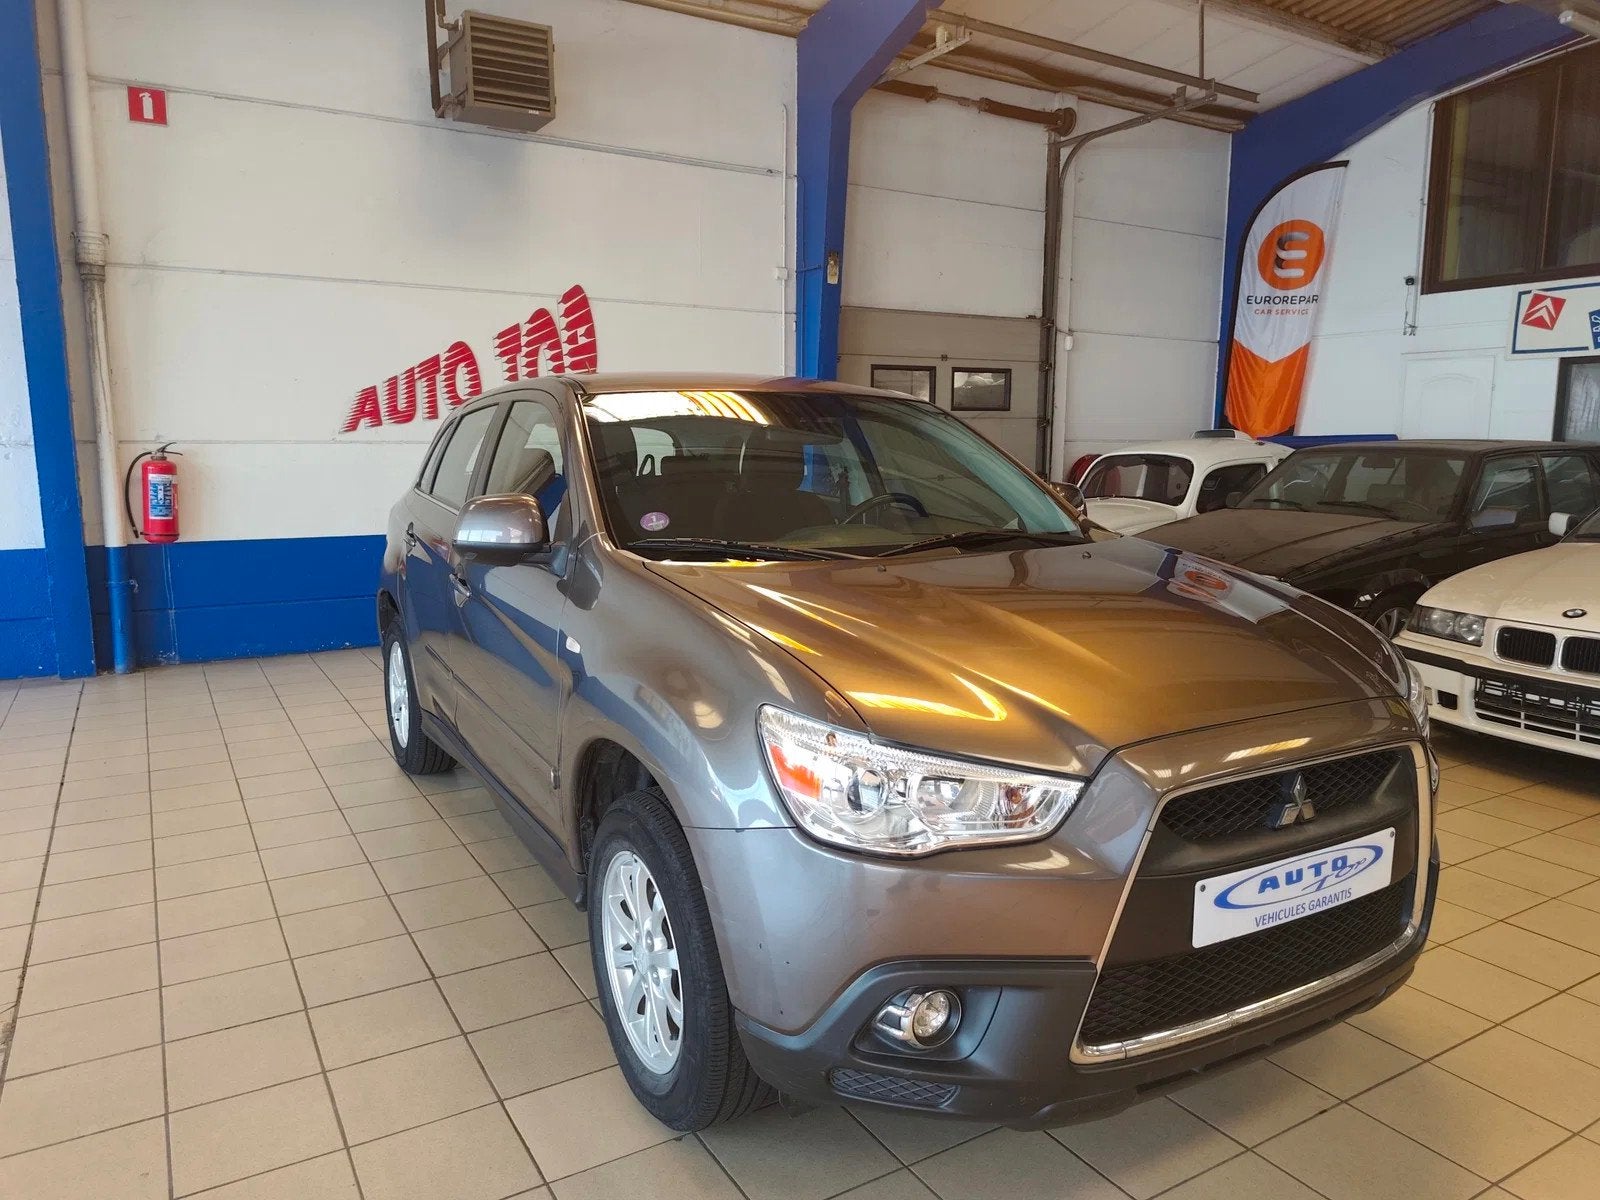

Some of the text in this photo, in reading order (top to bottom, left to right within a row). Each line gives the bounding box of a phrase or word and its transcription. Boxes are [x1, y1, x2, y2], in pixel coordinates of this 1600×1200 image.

[1246, 295, 1319, 305] EUROREPAR
[1254, 308, 1309, 316] CAR SERVICE
[339, 341, 482, 433] AUTO
[1258, 855, 1348, 894] AUTO
[1255, 888, 1352, 927] VEHICULES GARANTIS
